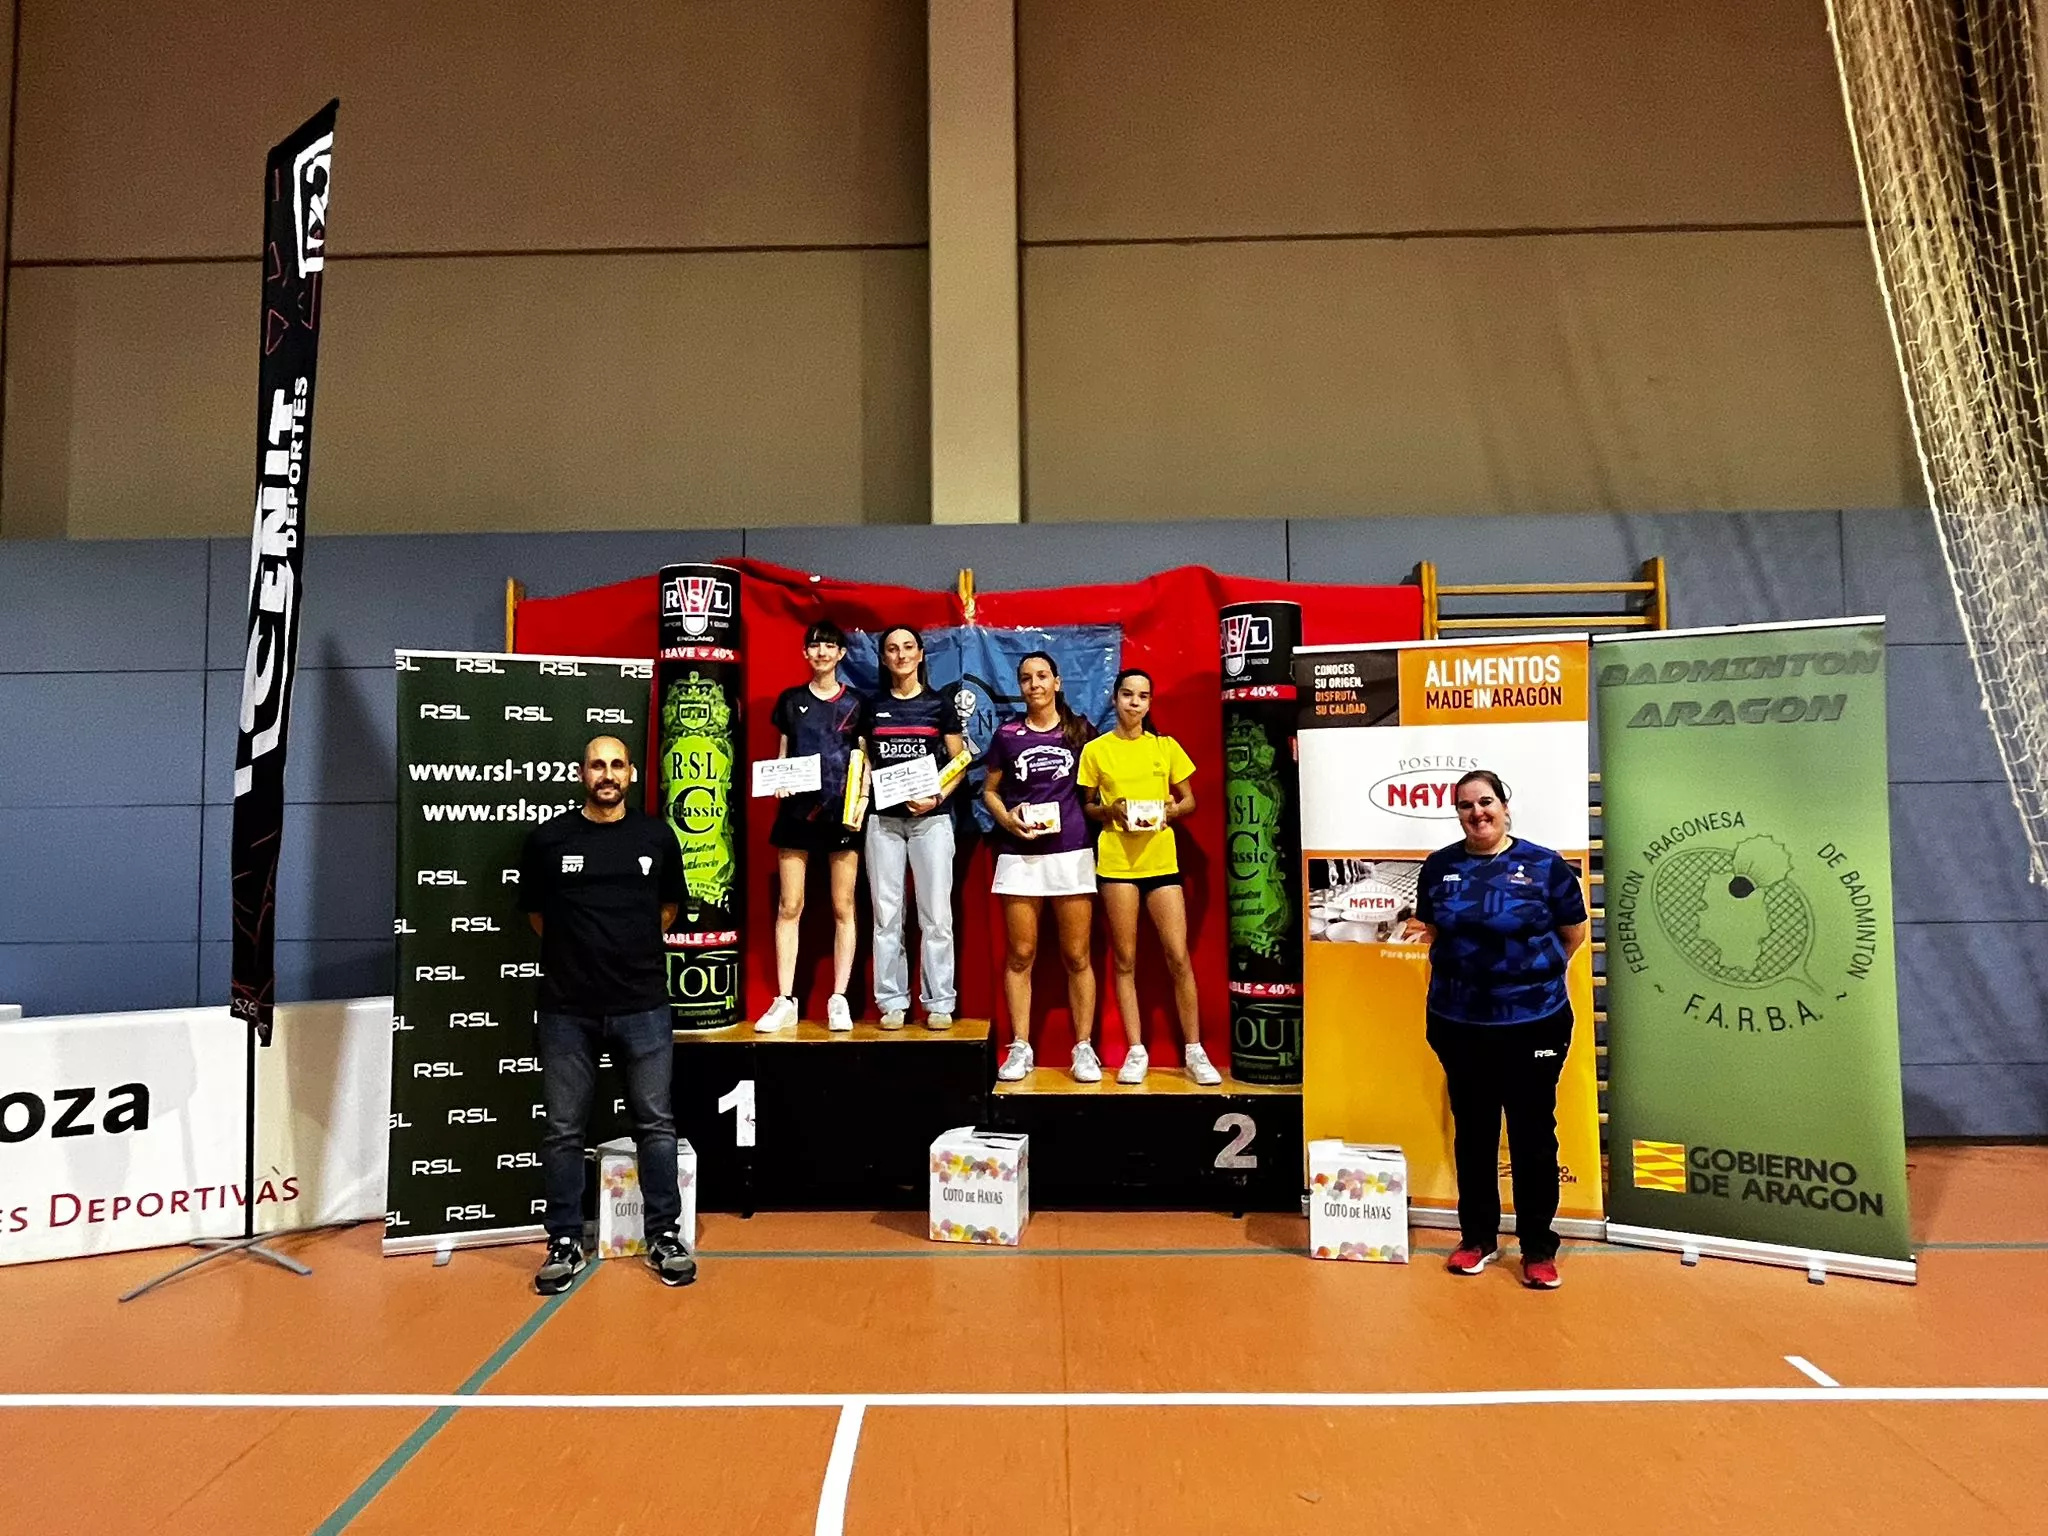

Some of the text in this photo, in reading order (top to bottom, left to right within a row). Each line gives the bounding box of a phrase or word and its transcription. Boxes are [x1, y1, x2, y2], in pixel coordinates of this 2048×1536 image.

[285, 376, 309, 549] DEPORTES
[664, 647, 735, 660] SAVE 40%
[396, 657, 653, 679] SL RSL RSL RS
[1314, 664, 1355, 676] CONOCES
[1424, 655, 1561, 688] ALIMENTOS
[1598, 650, 1882, 688] BADMINTON
[1249, 686, 1279, 697] 40%
[1315, 678, 1327, 689] SU
[1315, 690, 1357, 702] DISFRUTA
[420, 704, 633, 723] RSL RSL RSL
[1315, 703, 1367, 715] SU CALIDAD
[1626, 694, 1847, 729] ARAGON
[761, 763, 800, 774] RSL
[1398, 755, 1479, 771] POSTRES
[880, 767, 917, 783] RSL
[1387, 783, 1458, 809] NAY
[1232, 847, 1269, 864] assic
[417, 869, 468, 886] RSL
[1349, 898, 1395, 909] NAYEM
[1617, 811, 1877, 980] FEDERACION ARAGONESA DE BADMINTON
[451, 917, 500, 932] RSL
[1380, 949, 1403, 959] Para
[415, 963, 544, 982] RSL RSL
[1268, 983, 1296, 995] 40%
[392, 1012, 499, 1032] SL RSL
[413, 1058, 543, 1078] RSL RSL
[0, 1082, 150, 1143] oza
[389, 1108, 497, 1130] SL RSL
[718, 1080, 755, 1147] 1
[1213, 1112, 1258, 1169] 2
[412, 1153, 543, 1176] RSL RSL
[1689, 1146, 1857, 1187] GOBIERNO
[50, 1176, 299, 1228] DEPORTIVAS
[943, 1187, 964, 1203] COTO
[977, 1187, 1004, 1205] HAYAS
[1689, 1171, 1884, 1218] DE ARAGON
[386, 1211, 410, 1227] SL
[446, 1204, 496, 1221] RSL
[615, 1202, 638, 1217] COTO
[1324, 1202, 1392, 1220] COTO DE HAYAS
